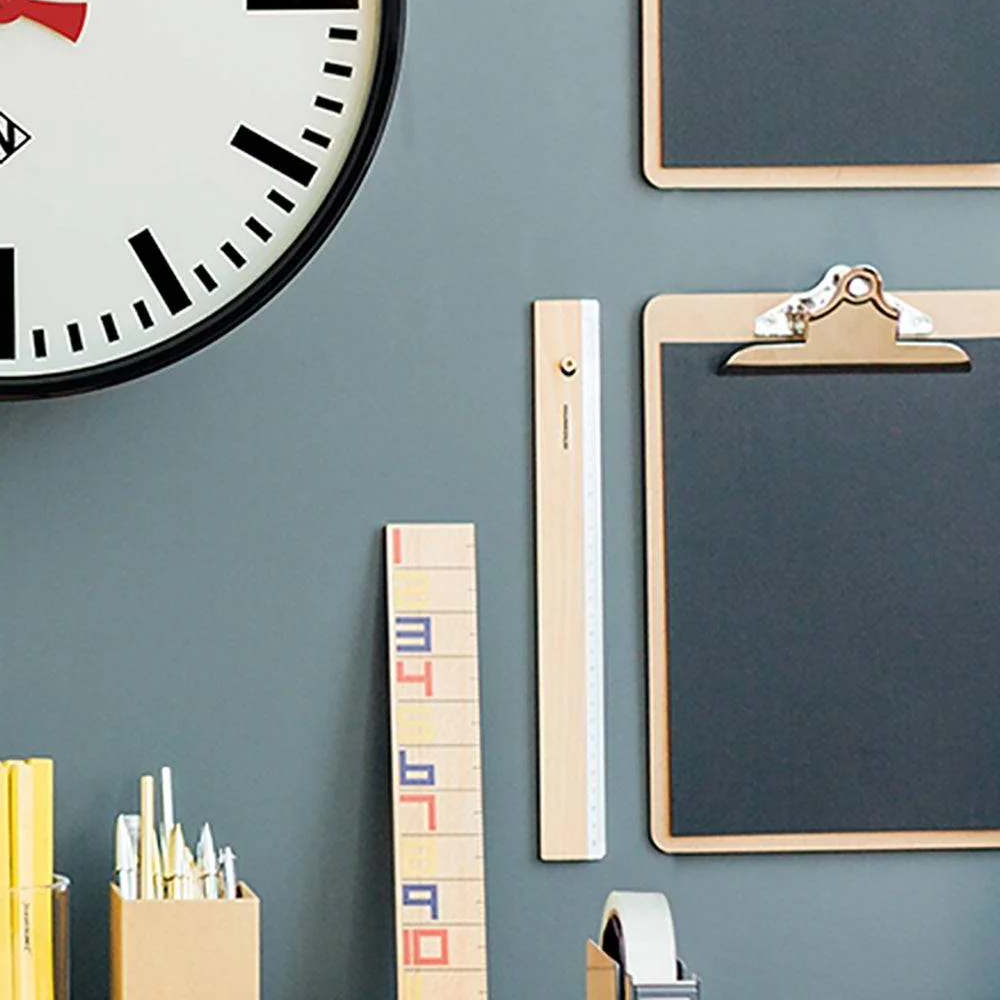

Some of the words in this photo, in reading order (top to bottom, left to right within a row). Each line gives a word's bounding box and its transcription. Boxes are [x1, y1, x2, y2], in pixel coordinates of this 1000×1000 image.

[396, 617, 431, 652] 3
[396, 661, 433, 697] 4
[399, 751, 434, 785] 6
[400, 795, 436, 830] 7
[402, 884, 438, 920] 9
[403, 929, 448, 965] 10
